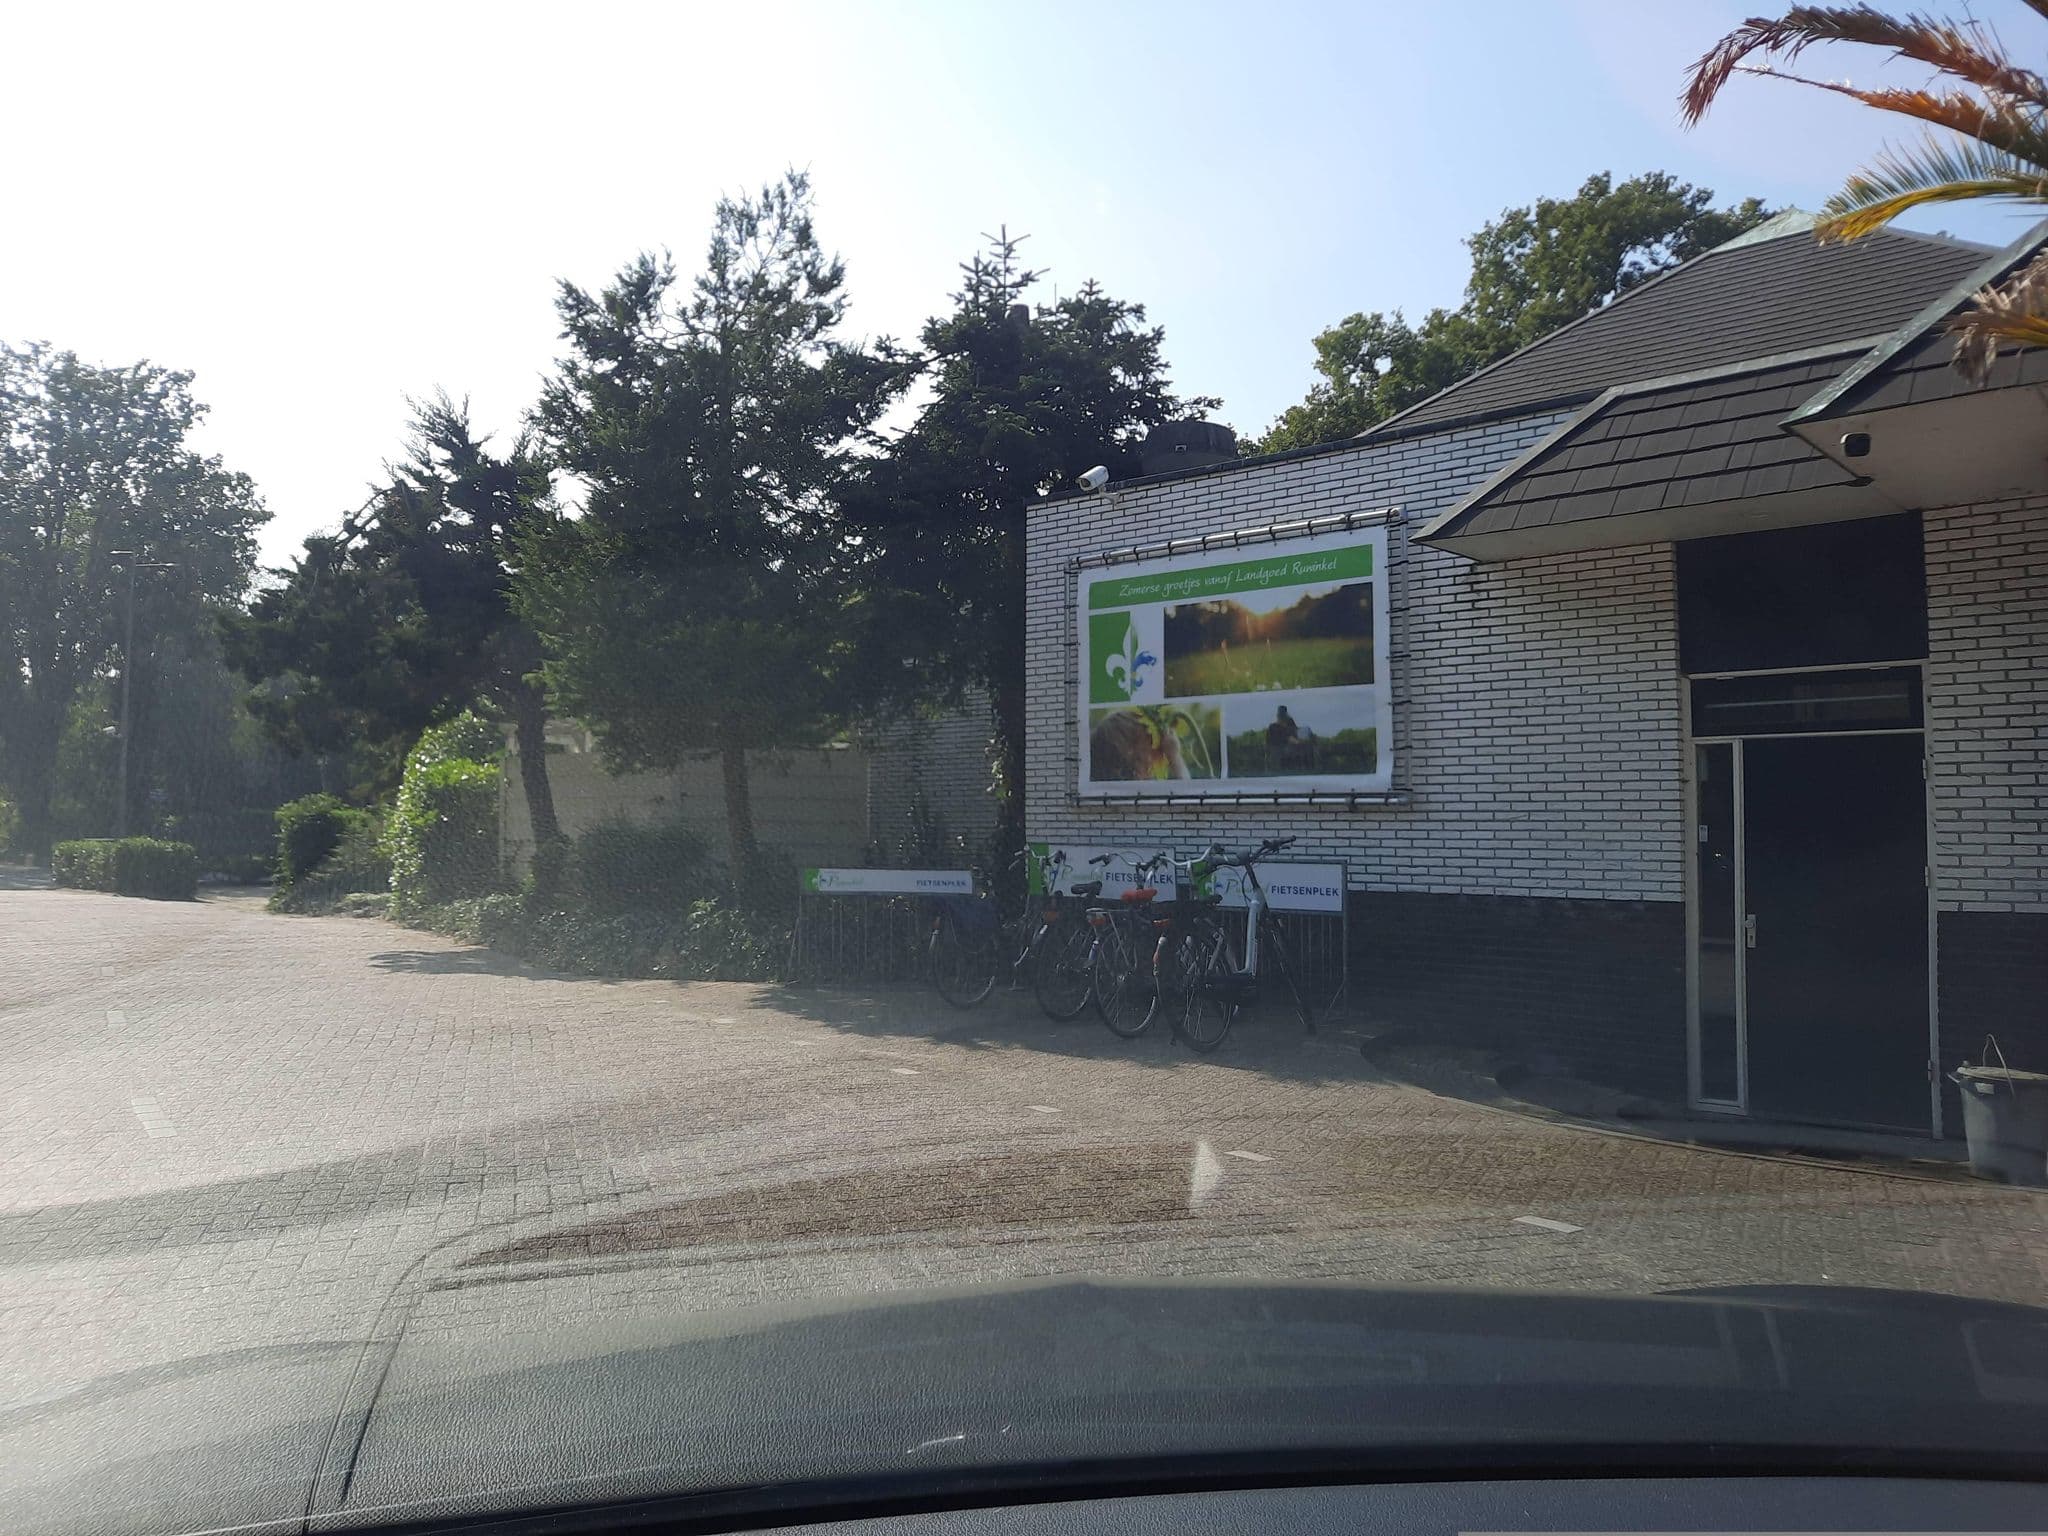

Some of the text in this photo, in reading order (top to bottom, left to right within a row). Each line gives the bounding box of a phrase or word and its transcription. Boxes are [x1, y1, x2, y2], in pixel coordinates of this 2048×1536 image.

[1119, 583, 1161, 598] Zomerse
[1161, 577, 1201, 598] groetjes
[1204, 570, 1233, 591] vanaf
[1235, 564, 1288, 585] Landgoed
[1271, 885, 1340, 897] FIETSENPLEK
